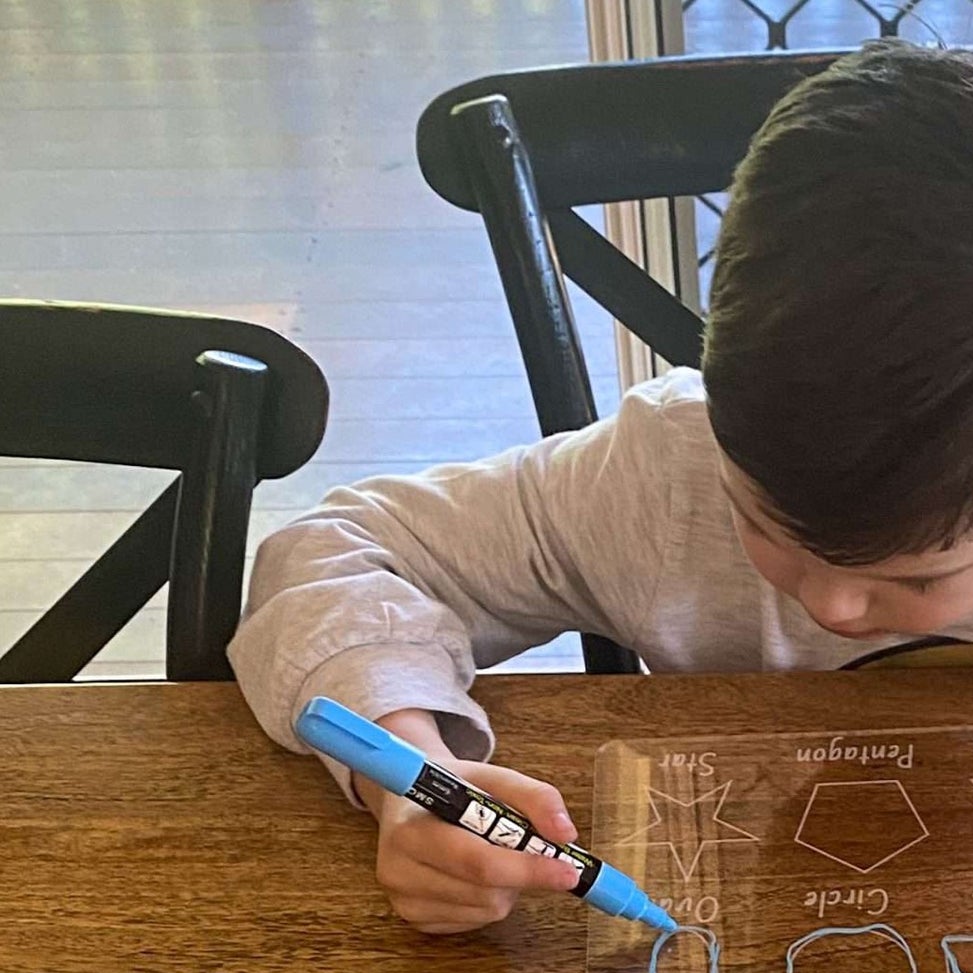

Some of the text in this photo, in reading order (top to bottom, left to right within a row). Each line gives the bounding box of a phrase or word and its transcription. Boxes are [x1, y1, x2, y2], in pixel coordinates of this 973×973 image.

[657, 751, 717, 777] Star
[796, 736, 915, 770] Pentagon
[652, 896, 720, 923] Ova
[803, 887, 889, 918] Circle
